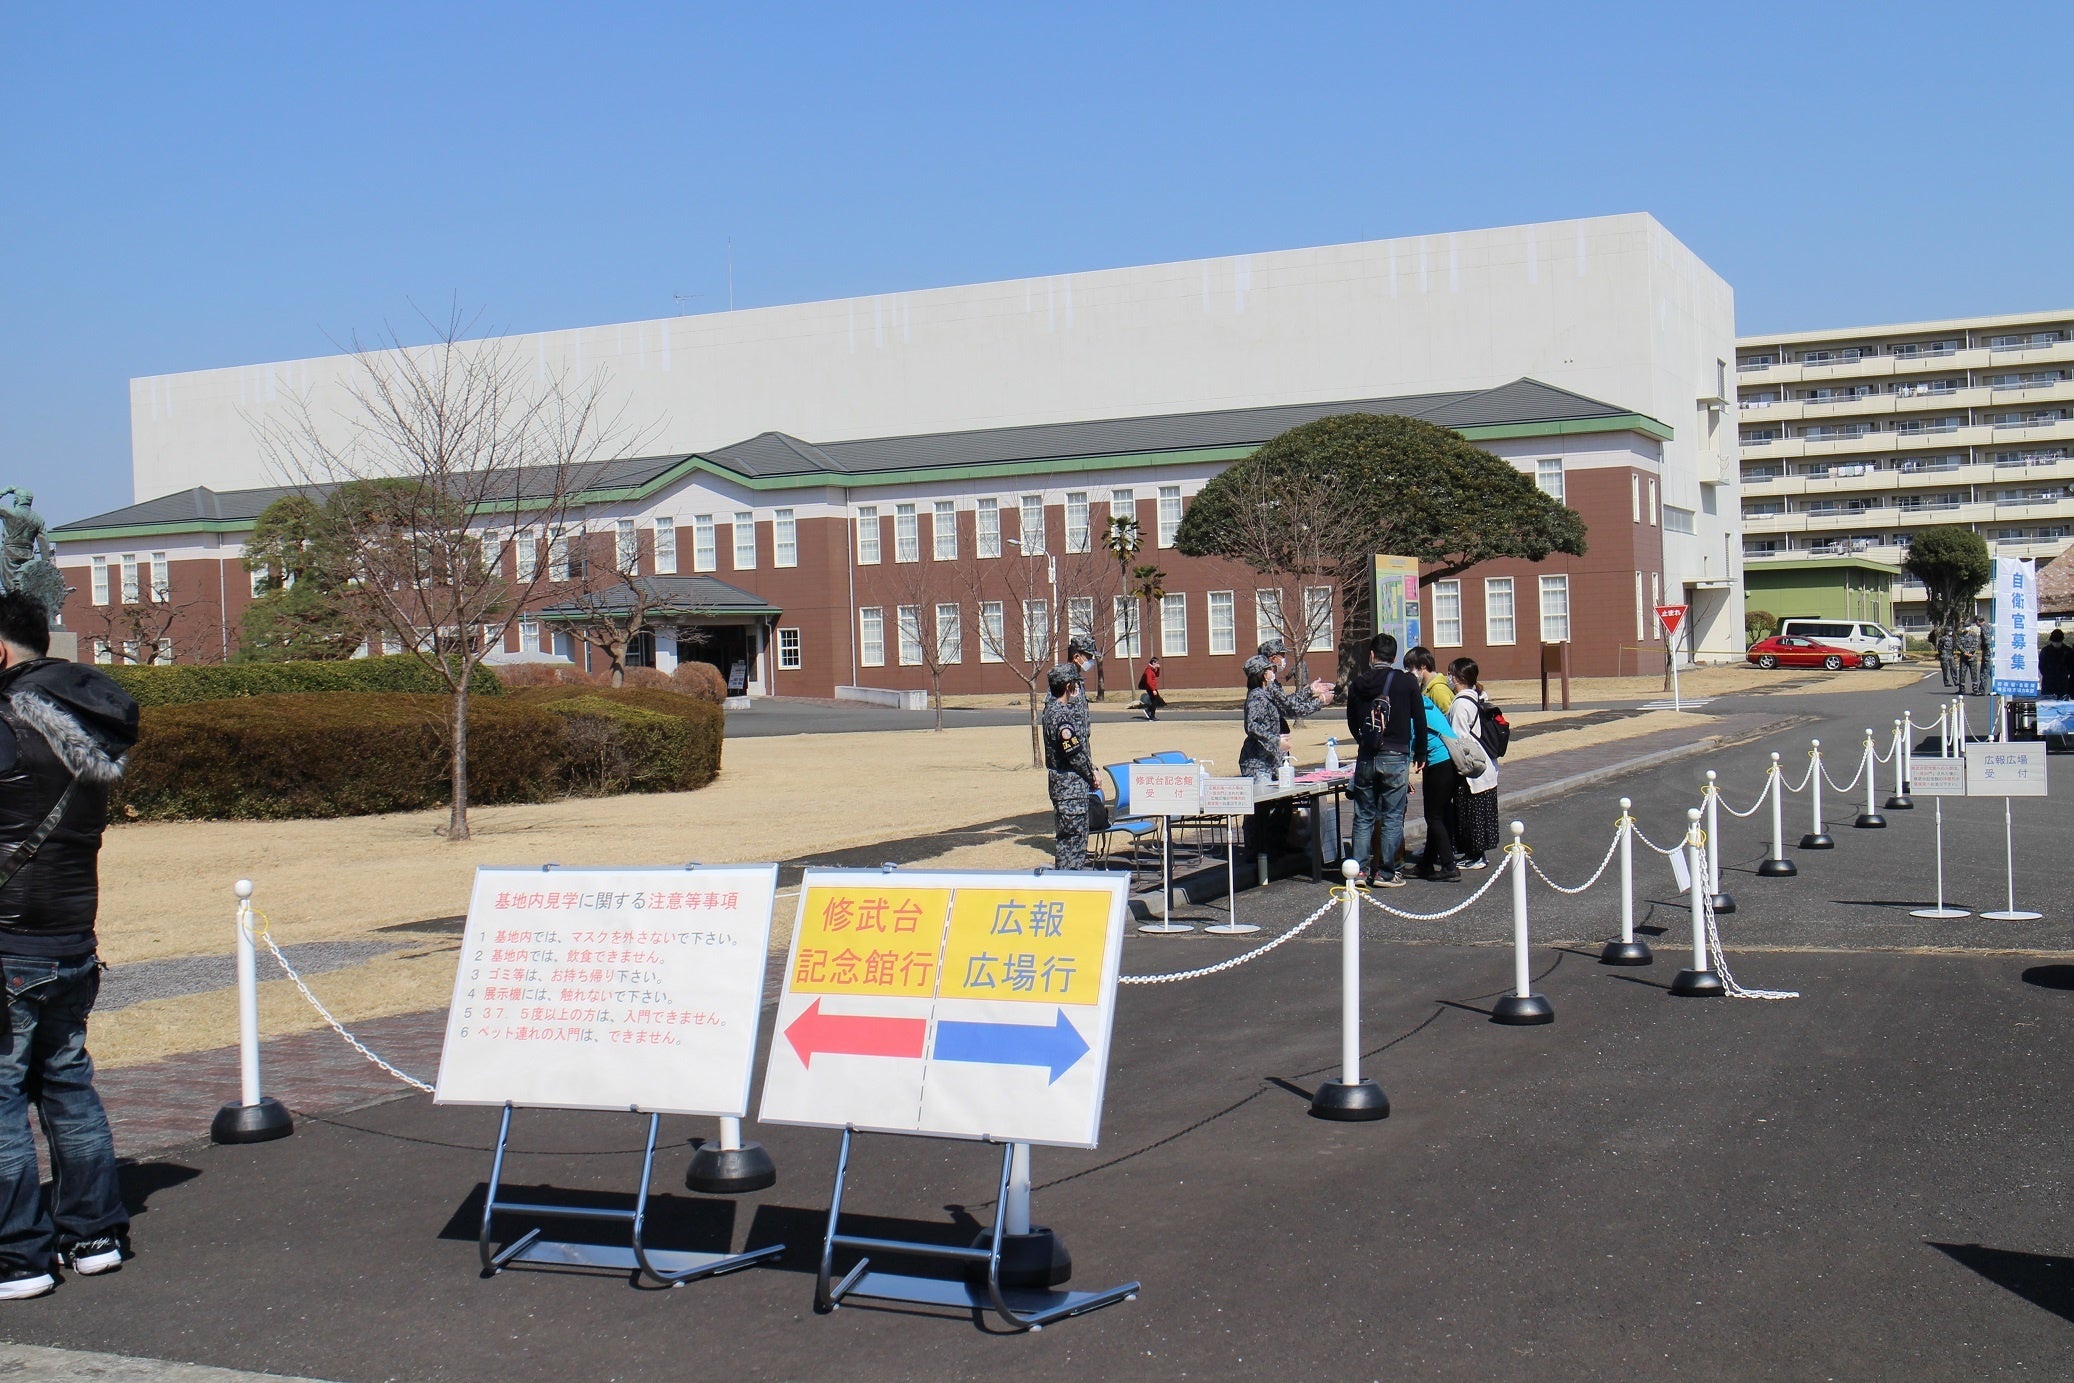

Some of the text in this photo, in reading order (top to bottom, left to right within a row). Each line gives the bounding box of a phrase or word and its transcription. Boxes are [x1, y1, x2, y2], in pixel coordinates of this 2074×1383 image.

[2010, 572, 2027, 671] 自衛官募集
[1984, 755, 2028, 765] 広報広場
[1135, 775, 1193, 786] 修武台記念館
[495, 891, 739, 910] 基地内見学に関する注意等事項
[822, 896, 924, 934] 修武台
[990, 898, 1065, 938] 広報
[480, 931, 486, 942] 1
[474, 950, 484, 961] 2
[795, 947, 934, 988] 記念館行
[963, 951, 1077, 993] 広場行
[471, 969, 480, 980] 3
[467, 989, 476, 999] 4
[464, 1007, 473, 1018] 5
[460, 1027, 469, 1038] 6
